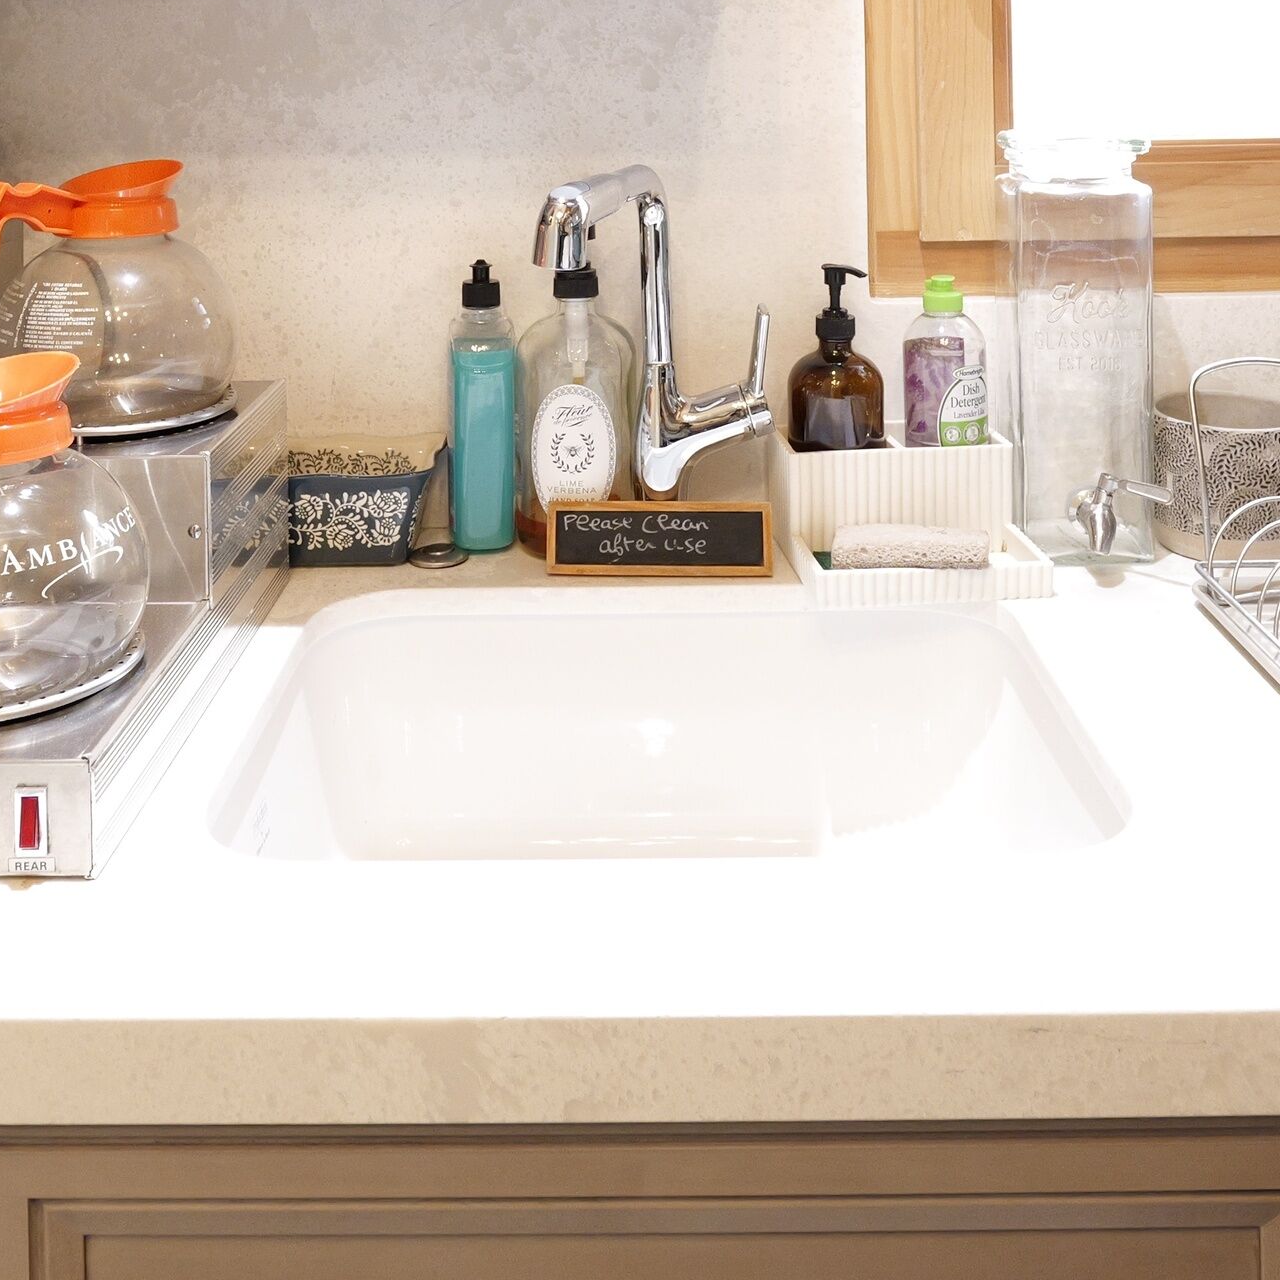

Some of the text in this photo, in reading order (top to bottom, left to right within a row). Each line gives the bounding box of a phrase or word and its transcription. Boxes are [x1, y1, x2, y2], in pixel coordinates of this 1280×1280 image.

[963, 382, 980, 396] Dish
[951, 395, 986, 408] Detergent
[599, 533, 656, 564] after
[14, 861, 48, 871] REAR
